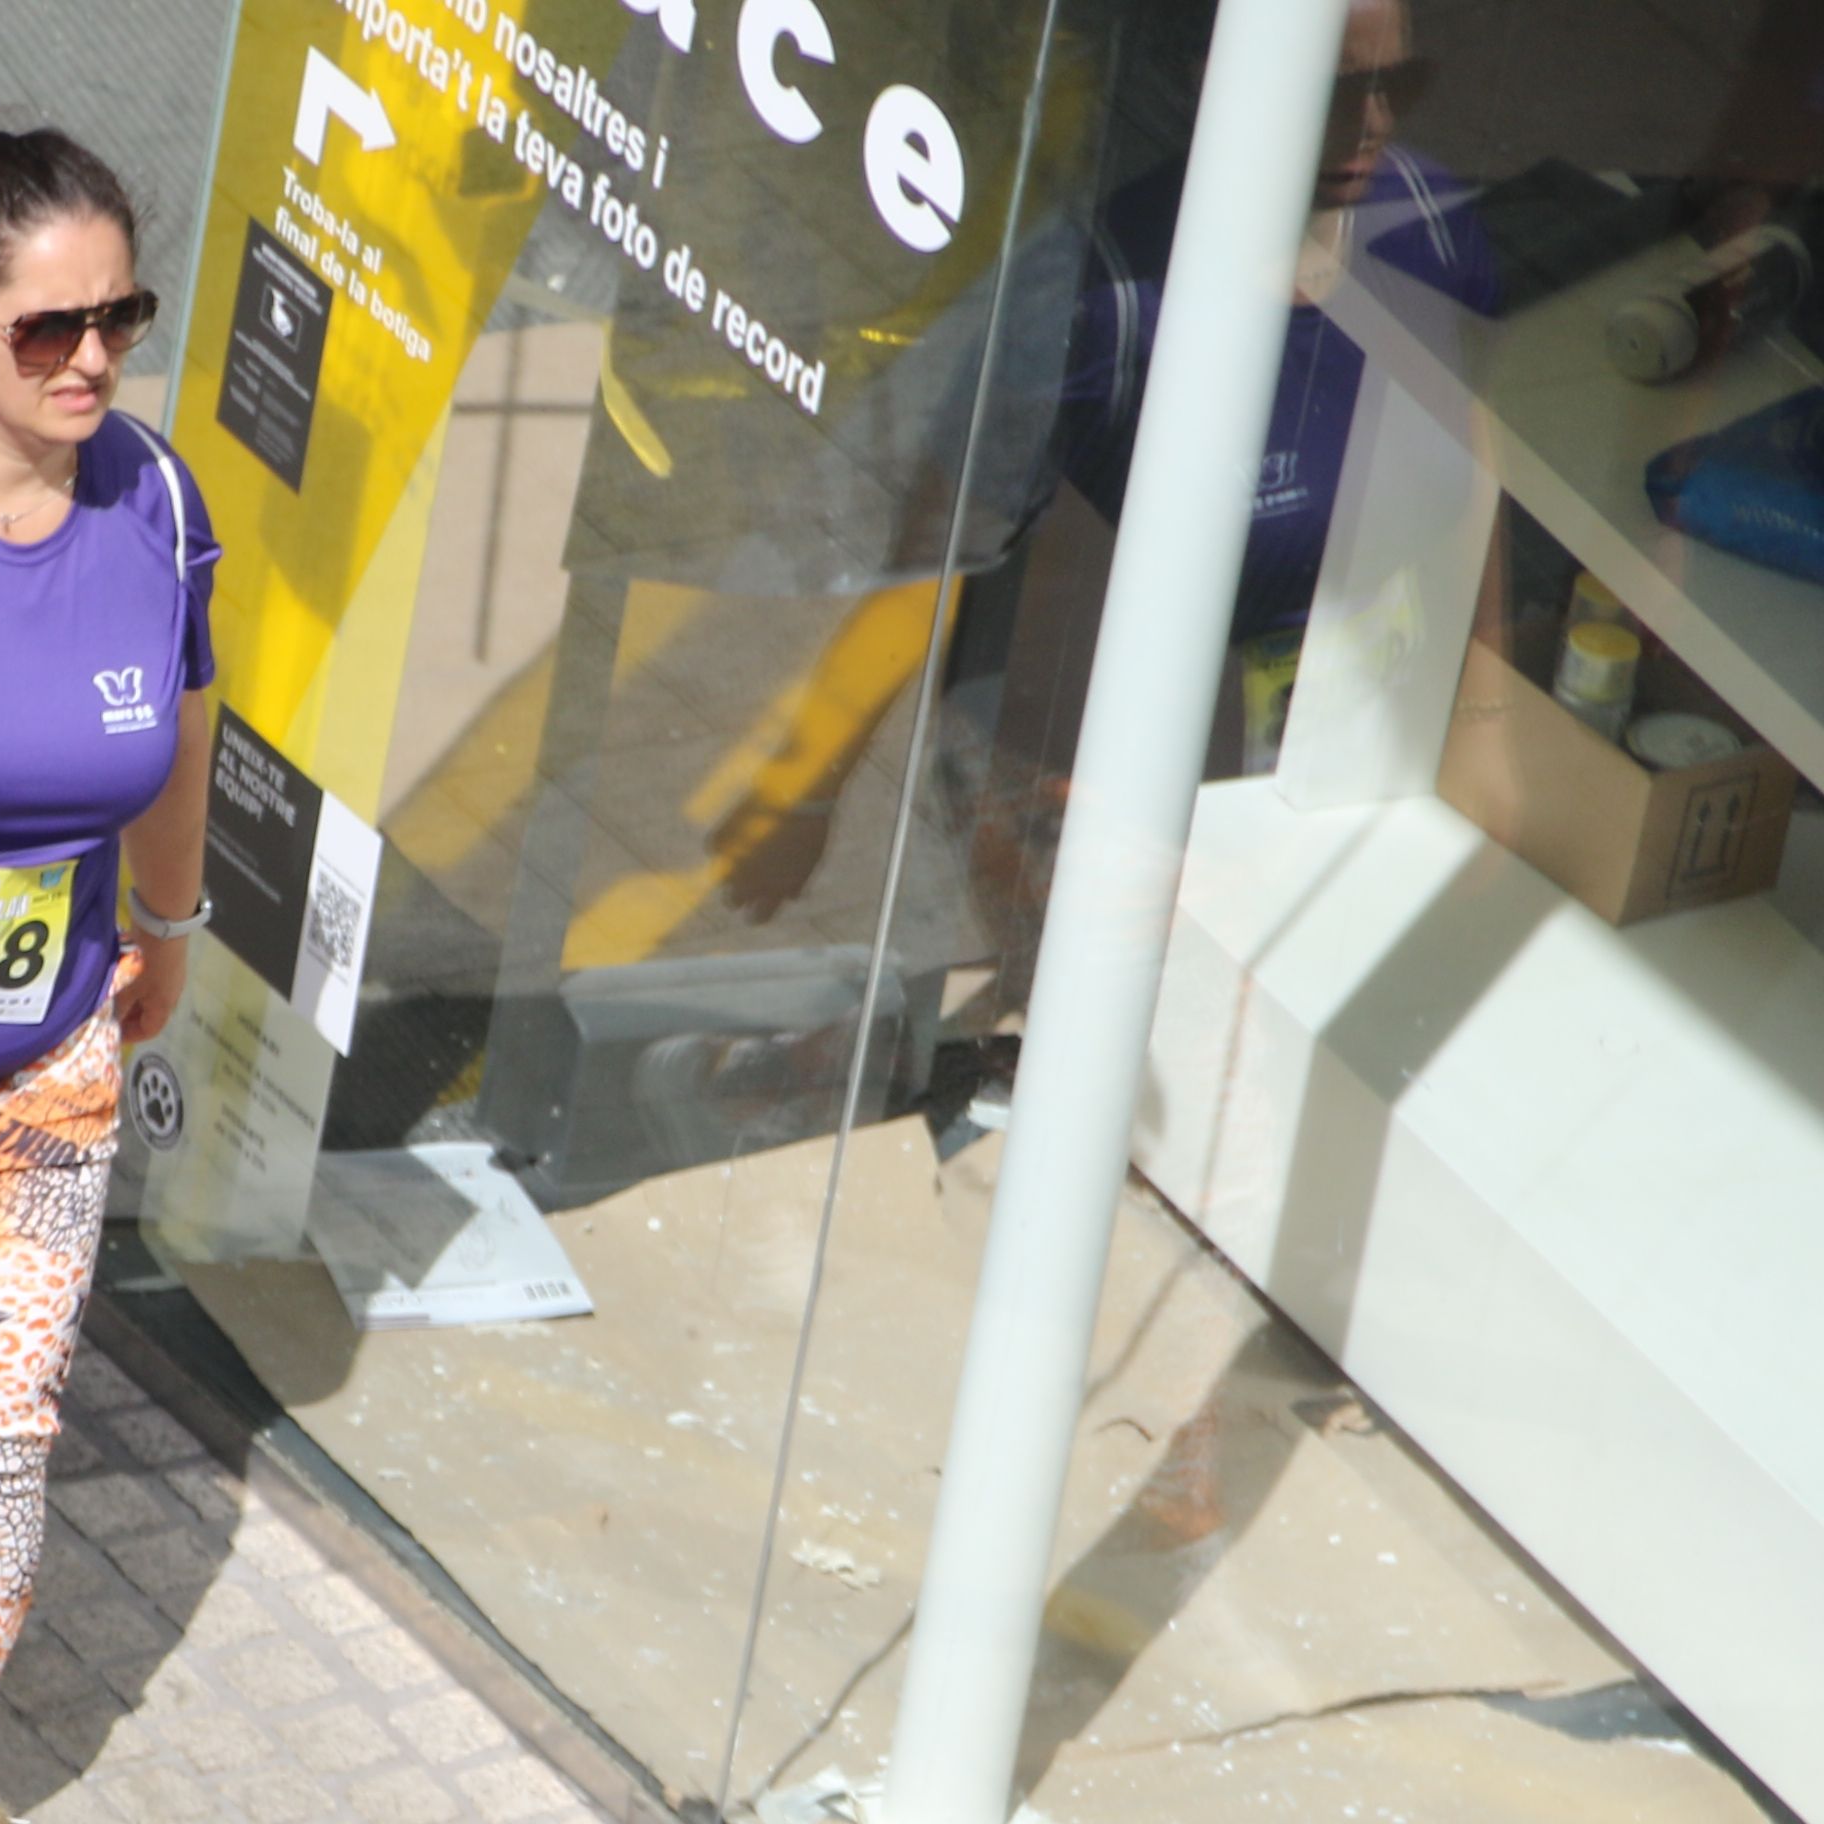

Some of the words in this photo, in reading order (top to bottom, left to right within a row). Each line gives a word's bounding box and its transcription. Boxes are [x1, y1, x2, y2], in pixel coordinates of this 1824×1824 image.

[494, 11, 647, 172] nosaltres
[653, 134, 669, 190] i
[275, 205, 319, 264] final
[320, 250, 346, 287] de
[348, 269, 367, 307] la
[370, 288, 433, 364] botiga
[283, 164, 359, 257] Troba-la
[361, 244, 383, 276] al
[477, 73, 508, 144] la
[514, 109, 585, 209] teva
[590, 172, 658, 270] foto
[663, 244, 707, 313] de
[712, 289, 827, 415] record
[237, 762, 297, 829] NOSTRE
